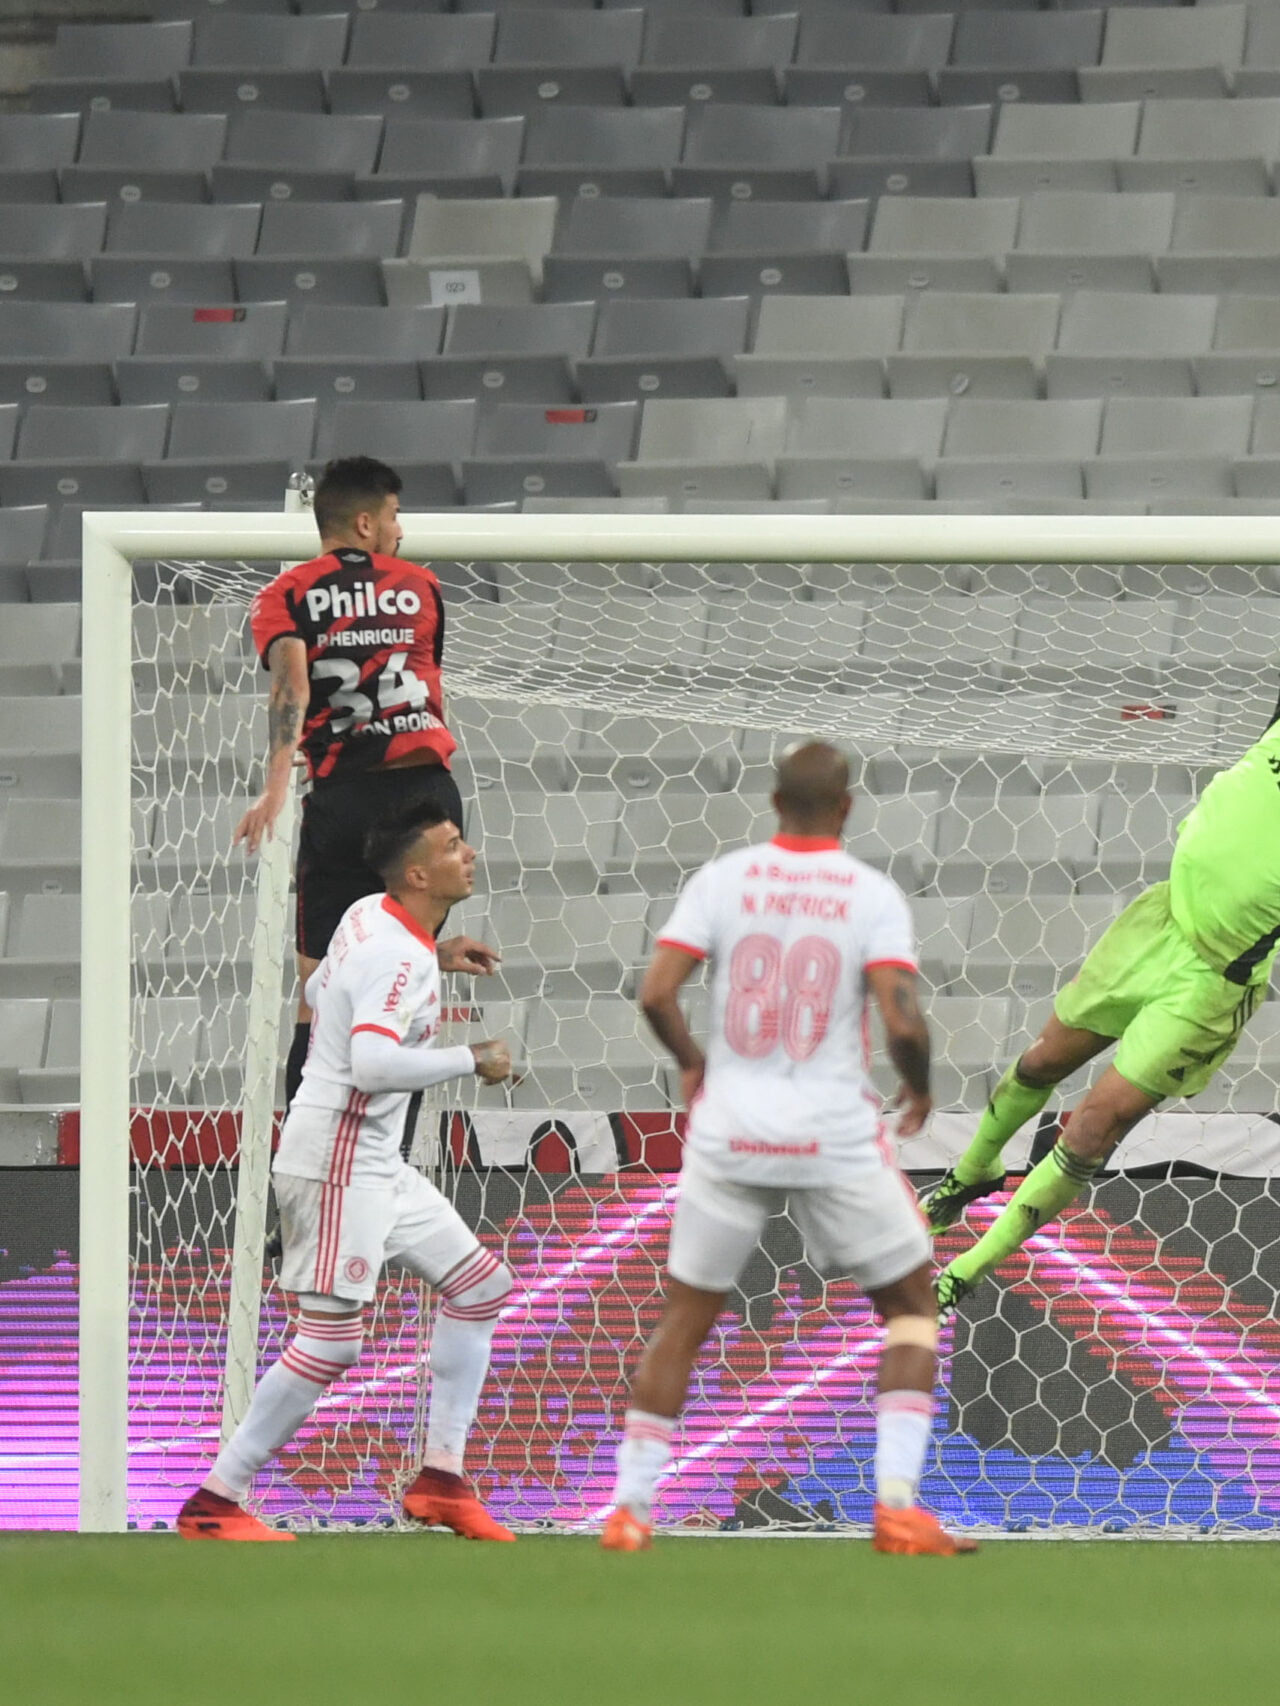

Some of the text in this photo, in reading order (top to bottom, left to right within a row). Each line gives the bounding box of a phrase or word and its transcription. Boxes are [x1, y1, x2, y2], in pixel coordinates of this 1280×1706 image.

[306, 581, 421, 622] Philco
[310, 652, 430, 734] 34
[724, 933, 842, 1062] 88
